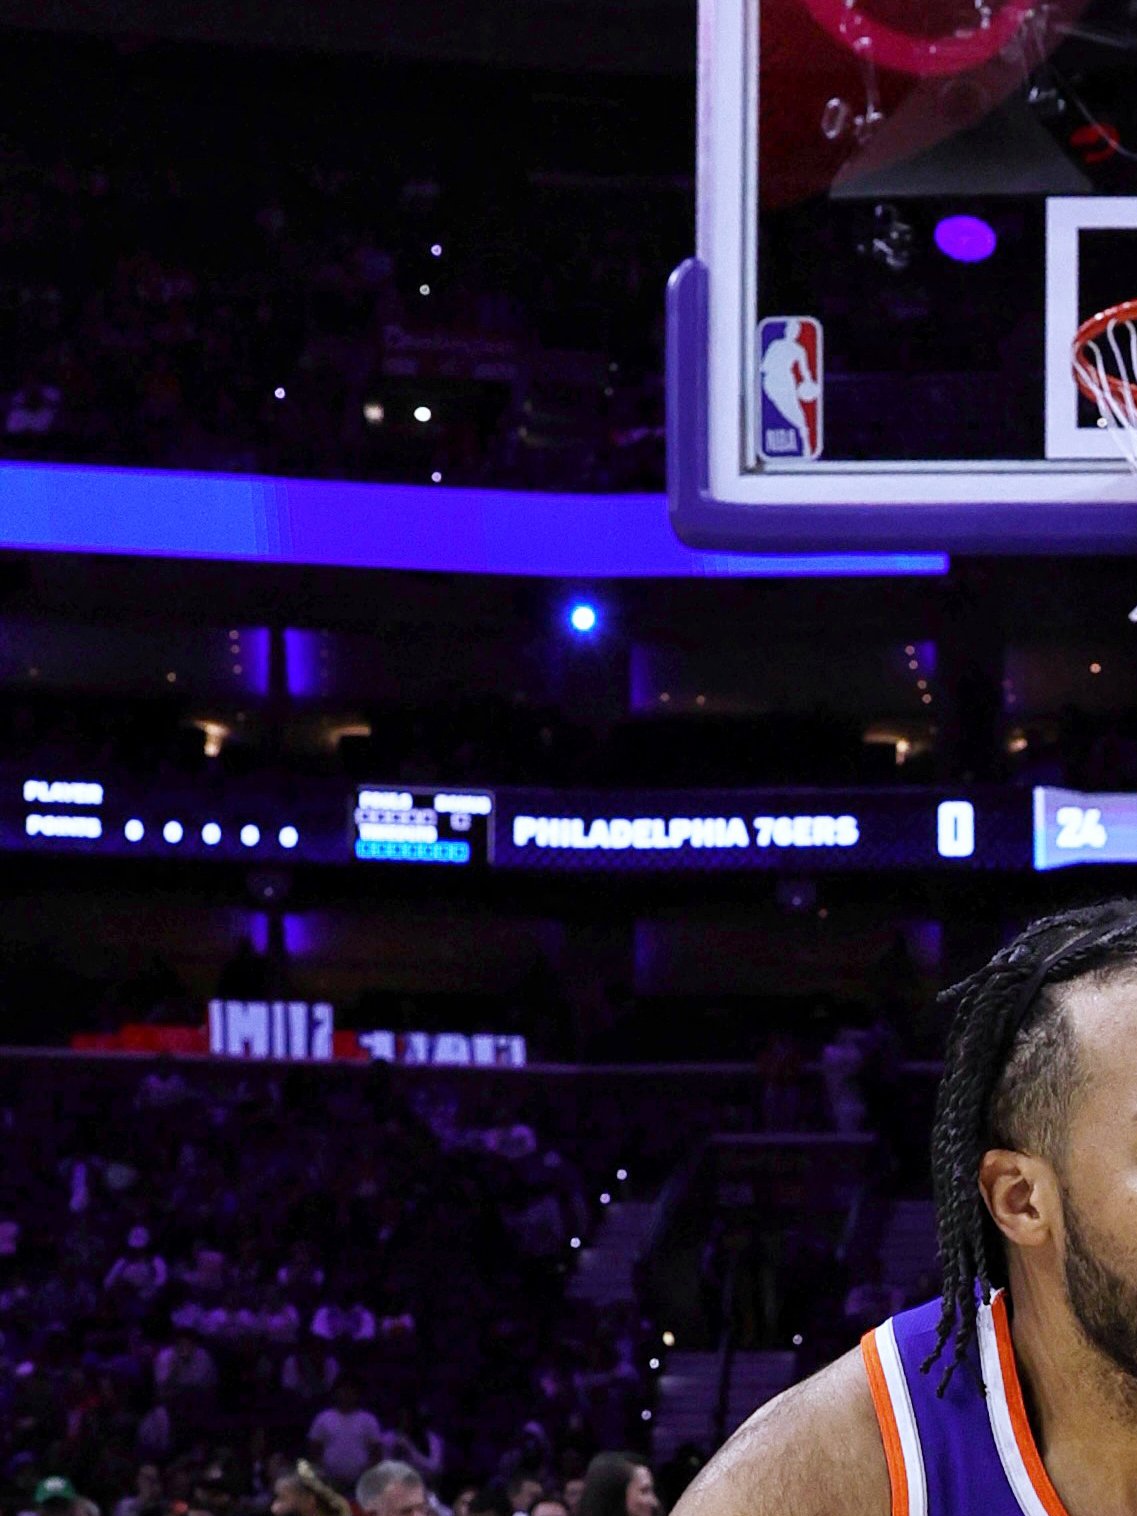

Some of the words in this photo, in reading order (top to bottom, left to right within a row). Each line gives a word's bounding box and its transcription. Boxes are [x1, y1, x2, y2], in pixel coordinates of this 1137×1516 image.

[513, 816, 750, 848] PHILADELPHIA
[753, 816, 860, 848] 76ERS
[937, 801, 975, 858] 0
[1055, 807, 1107, 849] 24
